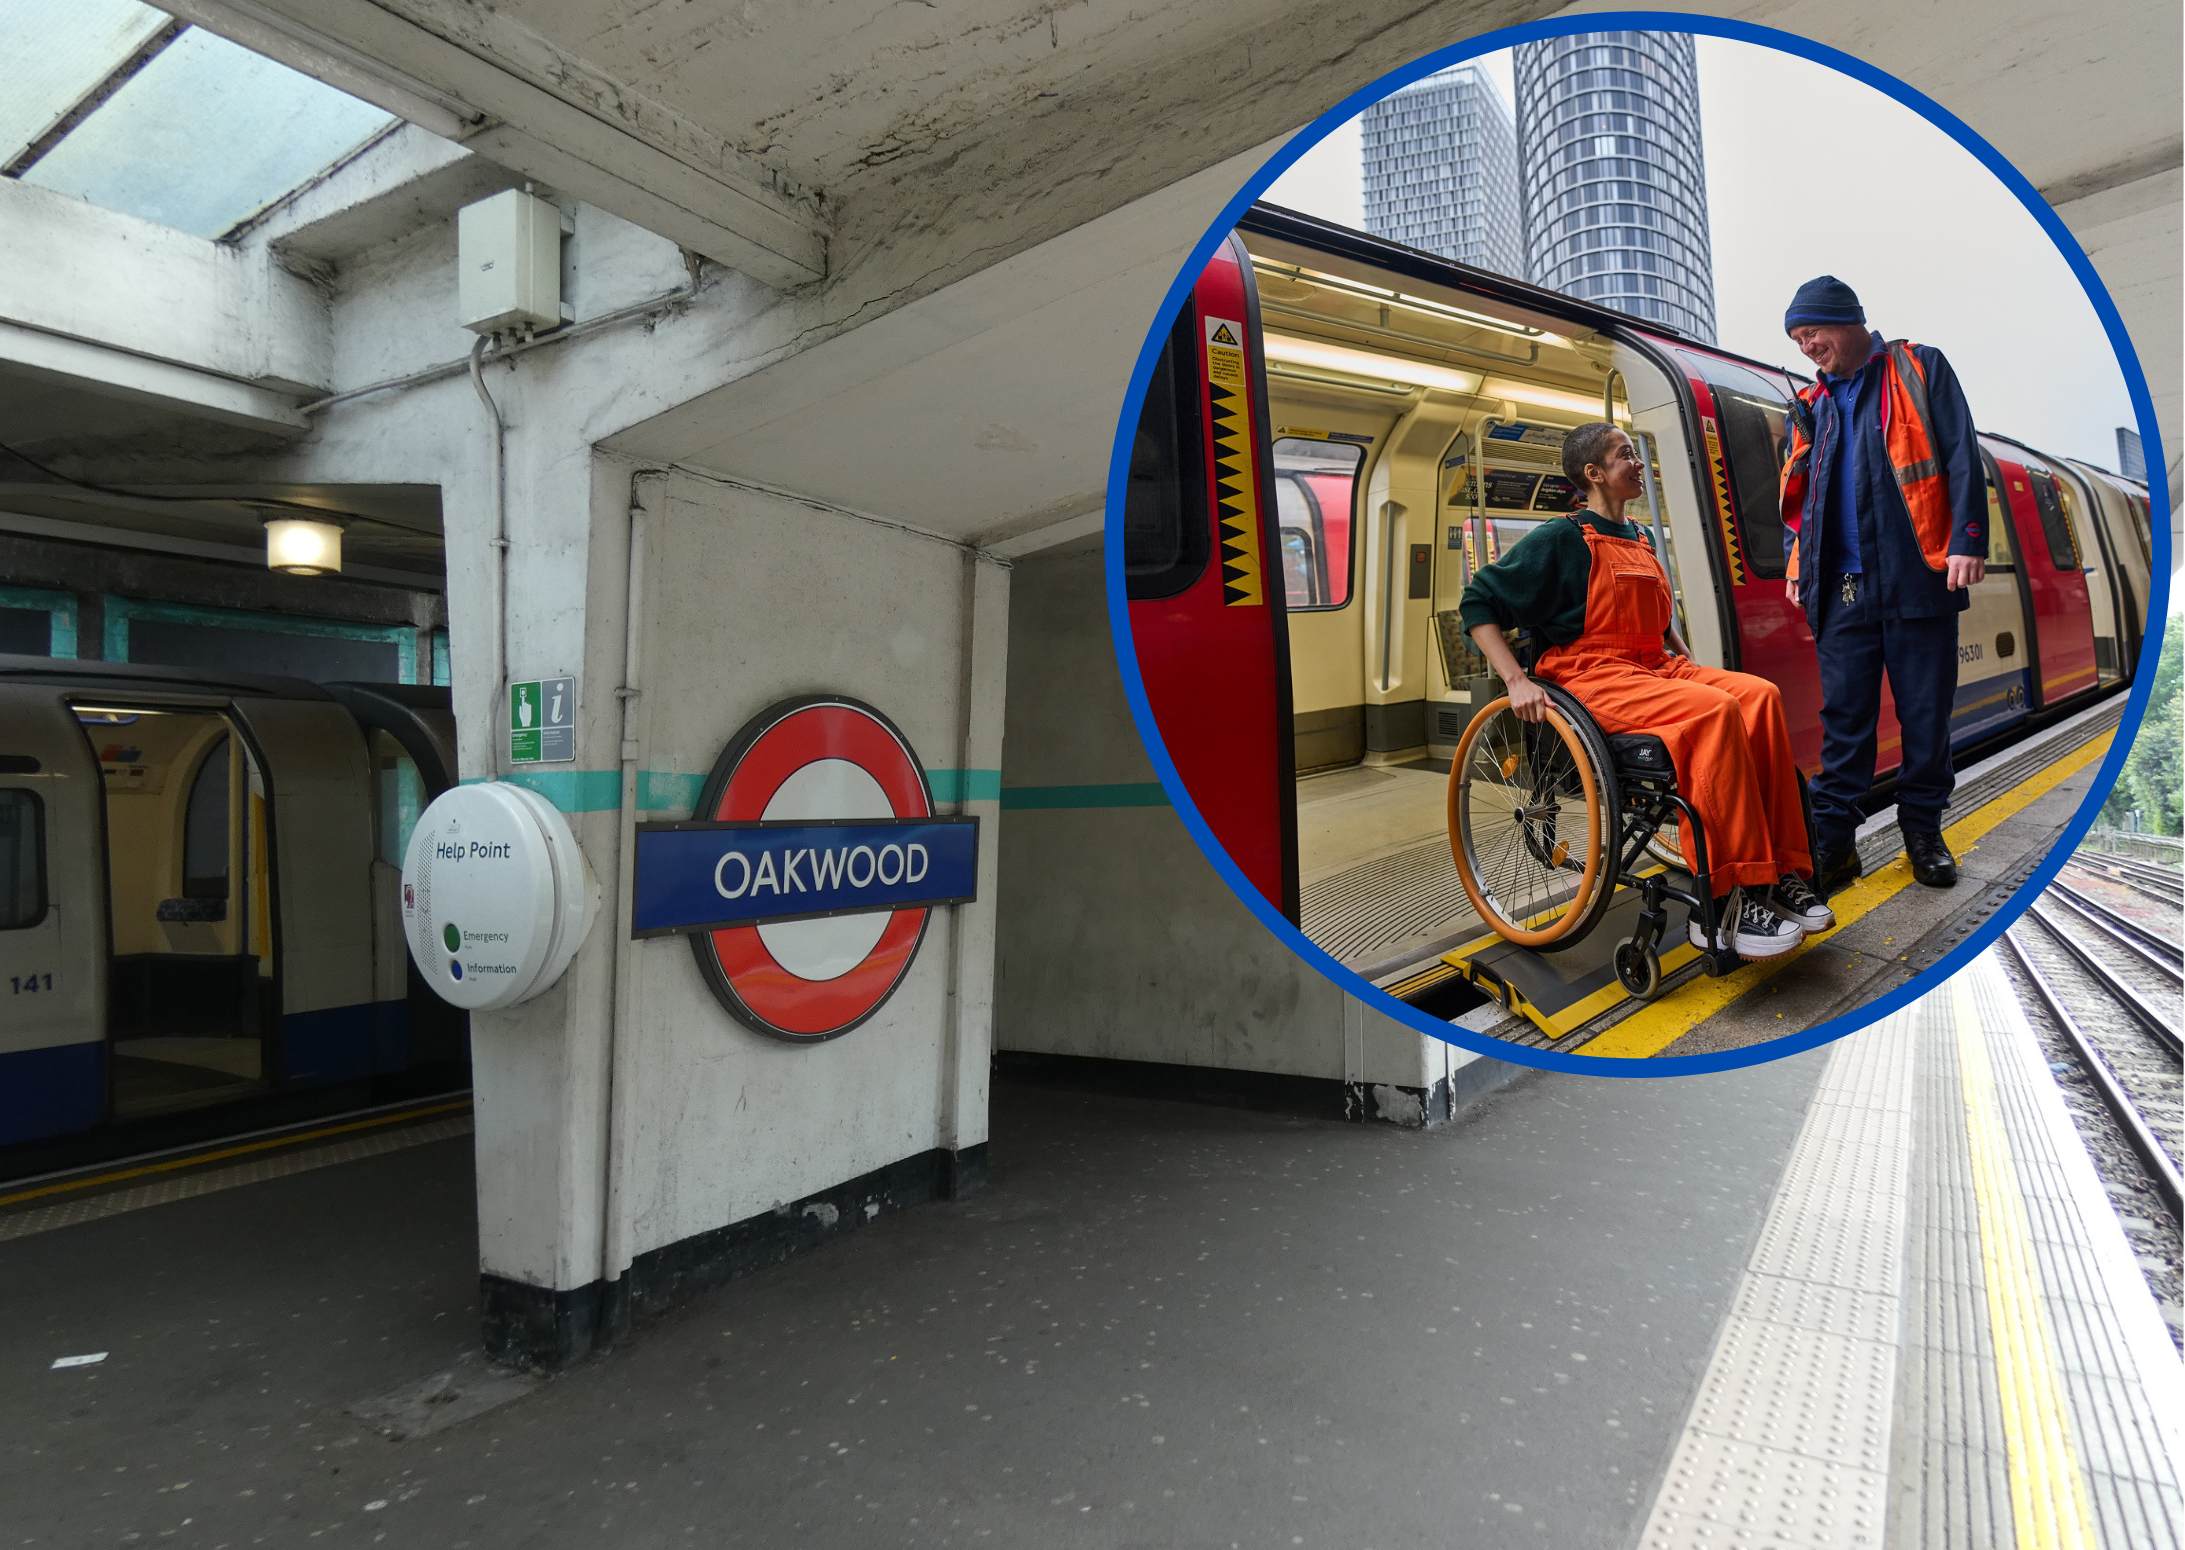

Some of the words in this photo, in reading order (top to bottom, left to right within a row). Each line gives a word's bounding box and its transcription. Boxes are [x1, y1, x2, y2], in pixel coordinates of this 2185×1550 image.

[436, 842, 466, 863] Help
[469, 841, 511, 859] Point
[714, 843, 929, 900] OAKWOOD
[463, 930, 509, 944] Emergency
[466, 962, 518, 974] Information
[10, 973, 53, 995] 141
